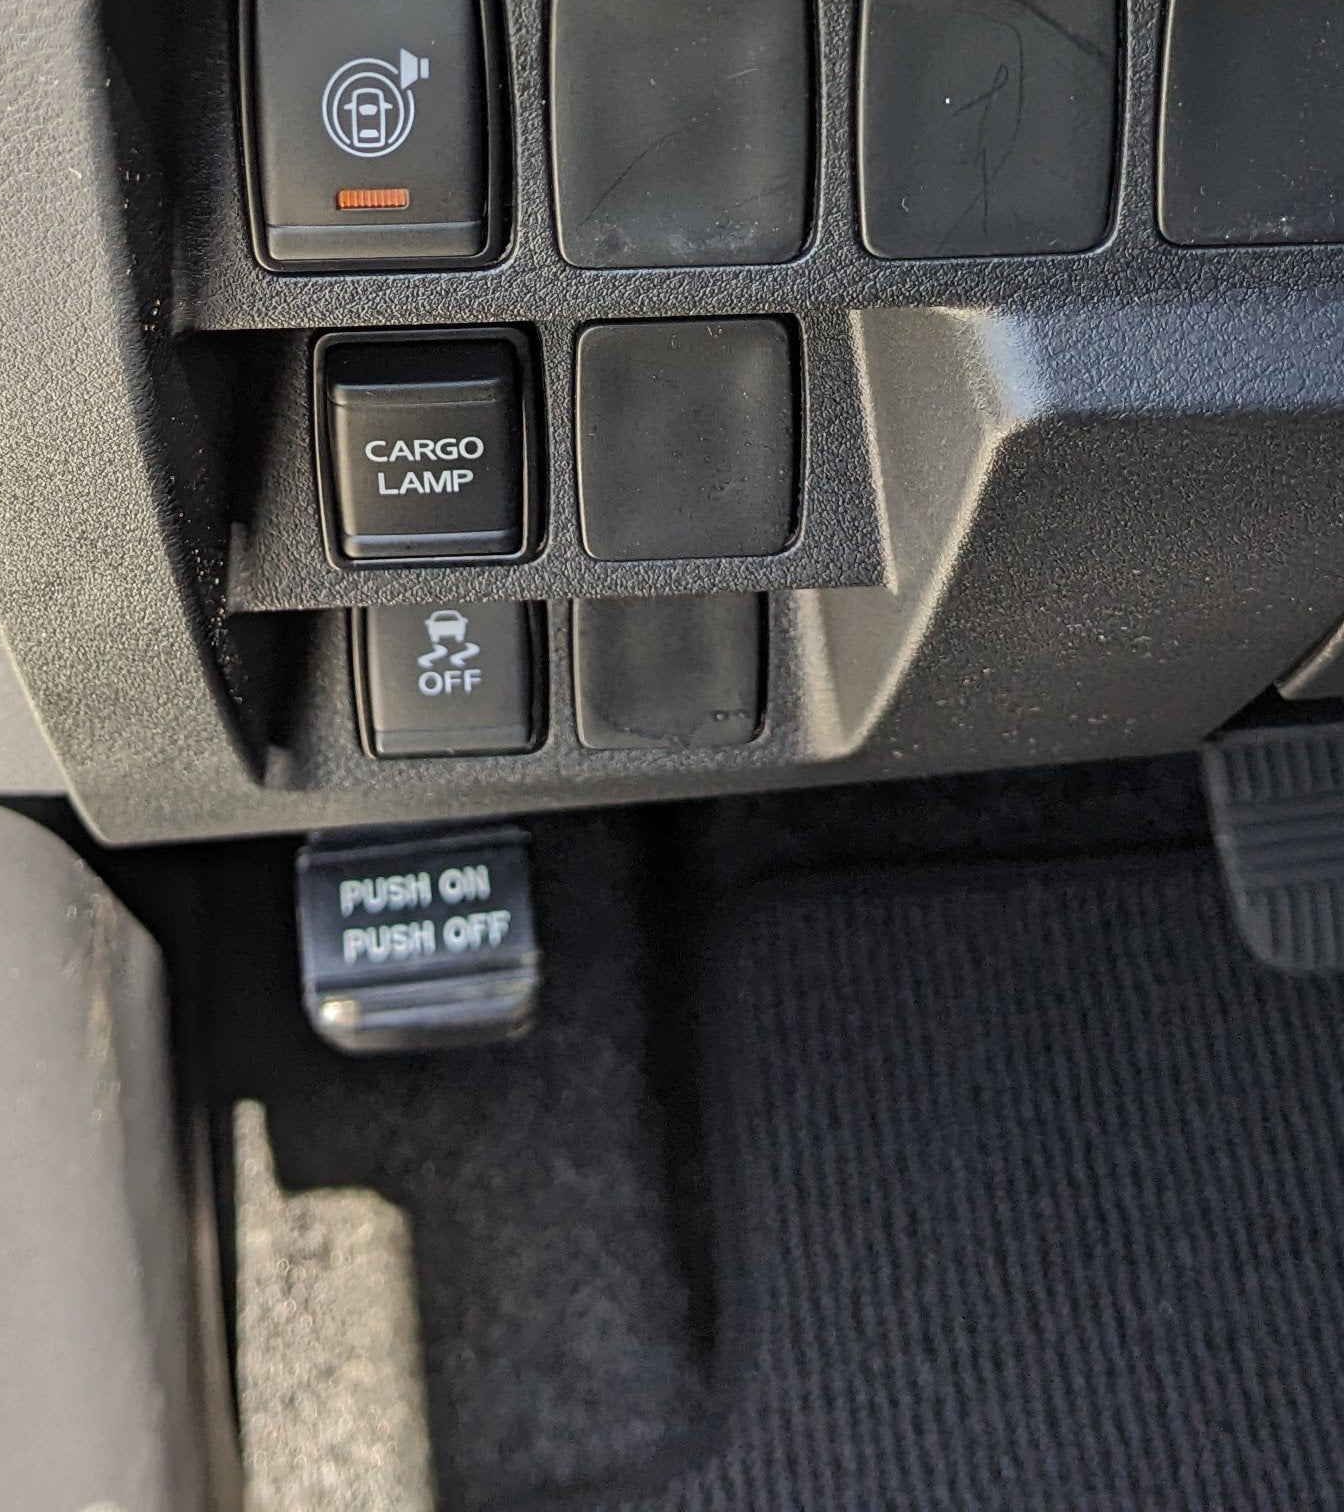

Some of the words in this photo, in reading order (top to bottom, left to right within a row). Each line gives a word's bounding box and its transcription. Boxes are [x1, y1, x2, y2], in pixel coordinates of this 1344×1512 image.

[364, 436, 485, 463] CARGO
[377, 469, 475, 496] LAMP
[417, 669, 483, 696] OFF
[338, 870, 433, 918] PUSH
[437, 864, 491, 905] ON
[342, 919, 437, 966] PUSH
[442, 909, 512, 953] OFF
